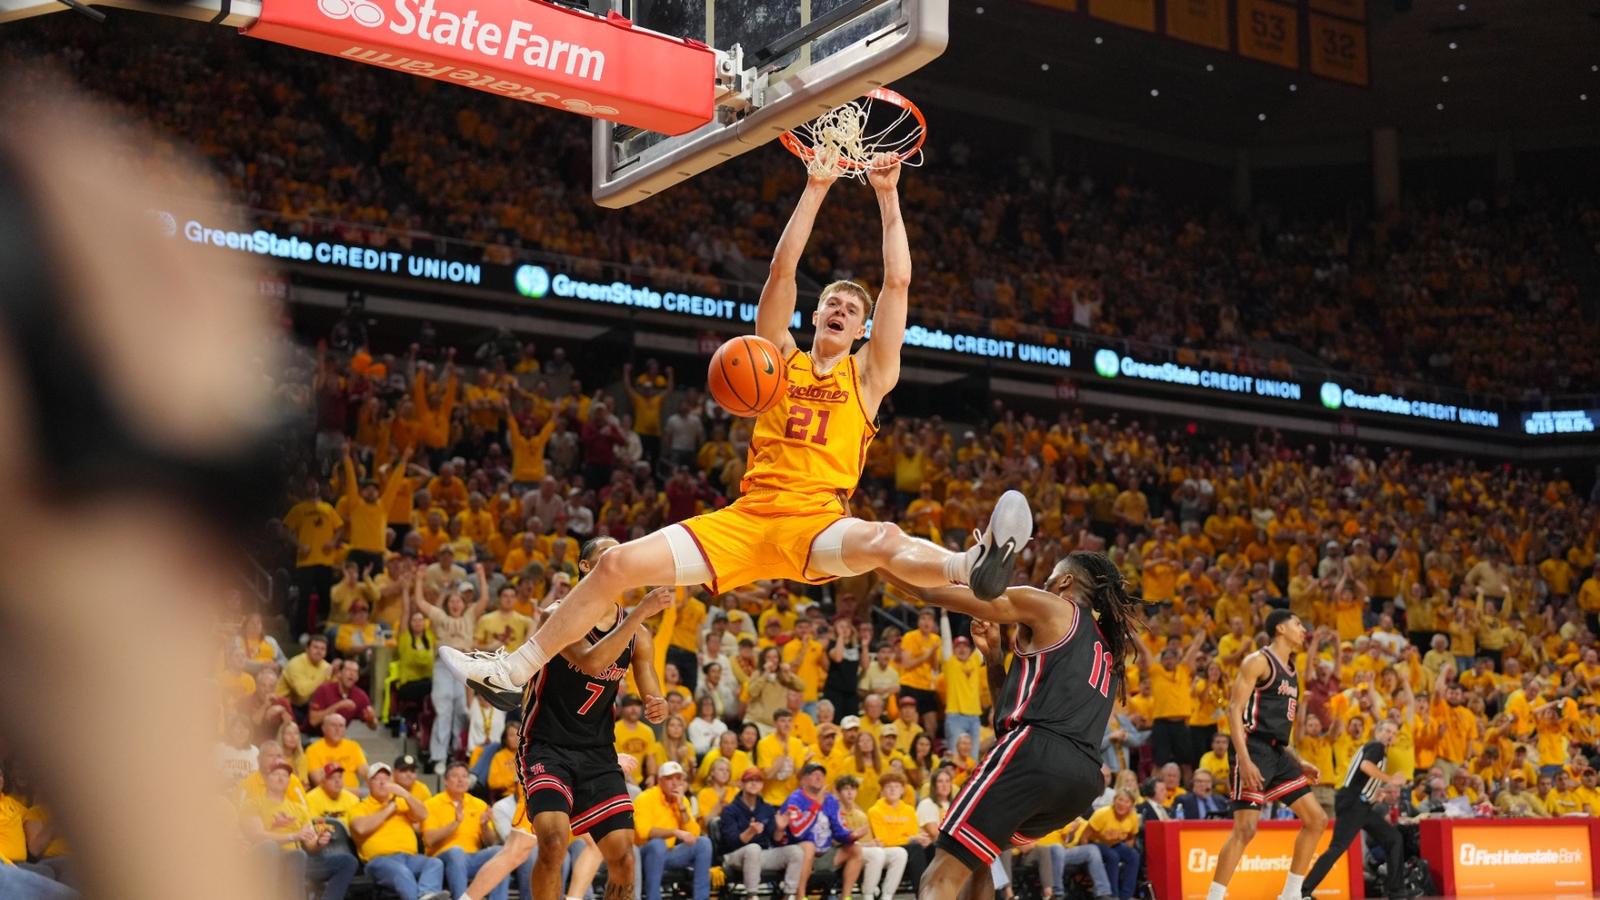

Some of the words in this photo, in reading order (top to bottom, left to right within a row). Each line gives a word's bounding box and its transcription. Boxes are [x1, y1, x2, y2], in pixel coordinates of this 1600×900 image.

[184, 220, 312, 260] GreenState
[315, 242, 402, 272] CREDIT
[408, 256, 481, 284] UNION
[552, 273, 661, 309] GreenState
[663, 292, 736, 319] CREDIT
[953, 334, 1015, 358] CREDIT
[1018, 344, 1071, 367] UNION
[787, 383, 849, 402] yclones
[1120, 356, 1200, 385] GreenState
[1200, 370, 1252, 392] CREDIT
[1255, 378, 1301, 400] UNION
[784, 405, 831, 446] 21
[1411, 400, 1457, 421] CREDIT
[1459, 407, 1499, 427] UNION
[1088, 641, 1113, 698] 11
[577, 682, 605, 716] 7
[1475, 849, 1503, 865] First
[1503, 849, 1559, 865] Interstate
[1560, 847, 1583, 864] Bank
